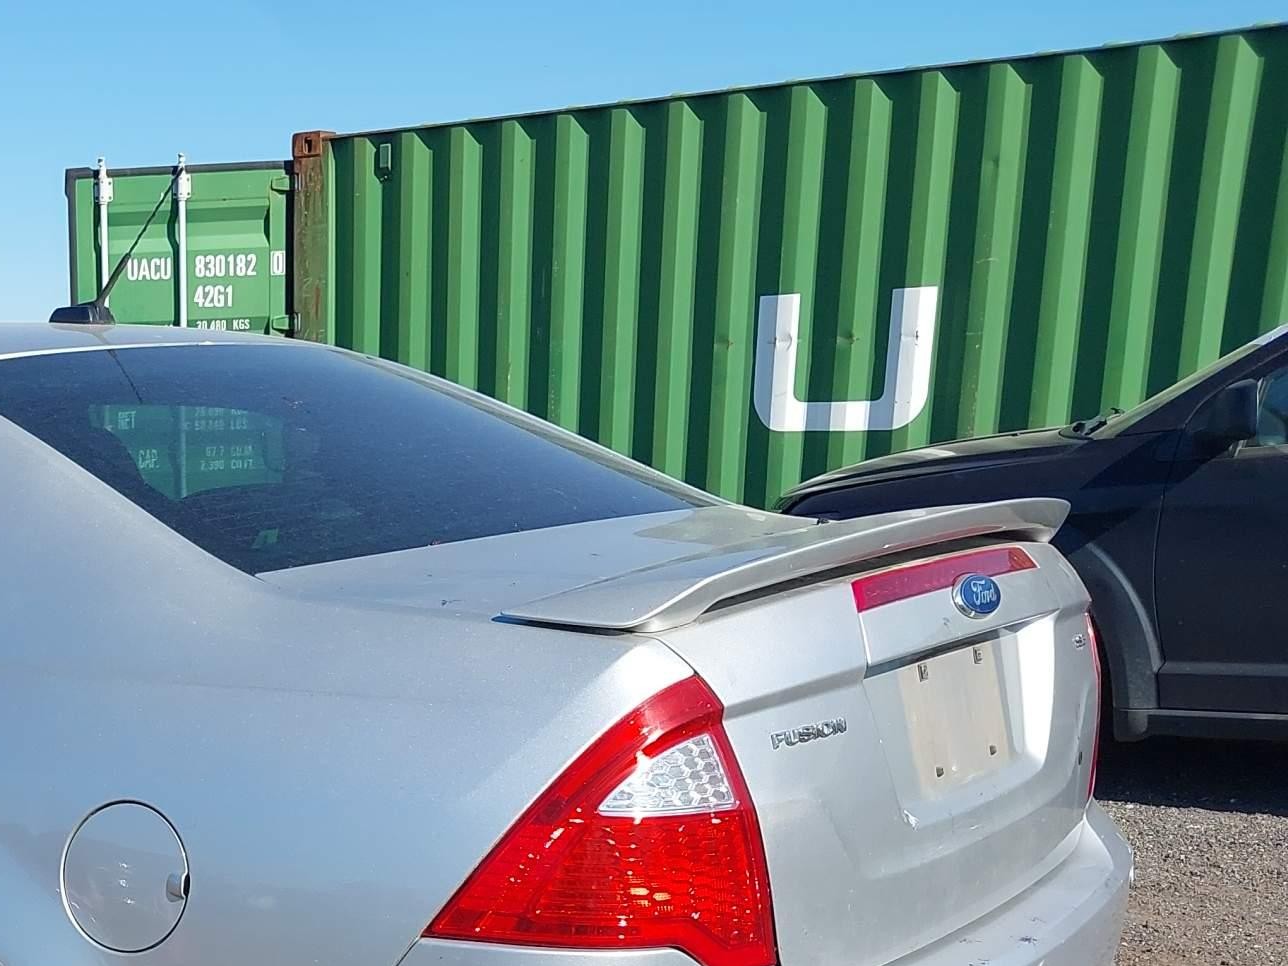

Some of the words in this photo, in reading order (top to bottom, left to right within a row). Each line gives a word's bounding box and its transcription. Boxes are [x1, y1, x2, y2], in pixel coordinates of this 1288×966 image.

[127, 258, 172, 280] UACU
[195, 254, 257, 277] 830182
[272, 252, 285, 274] 0
[194, 285, 233, 307] 42G1
[233, 319, 250, 330] KGS
[754, 287, 938, 431] U
[971, 580, 997, 606] Ford
[770, 717, 847, 750] FUSION
